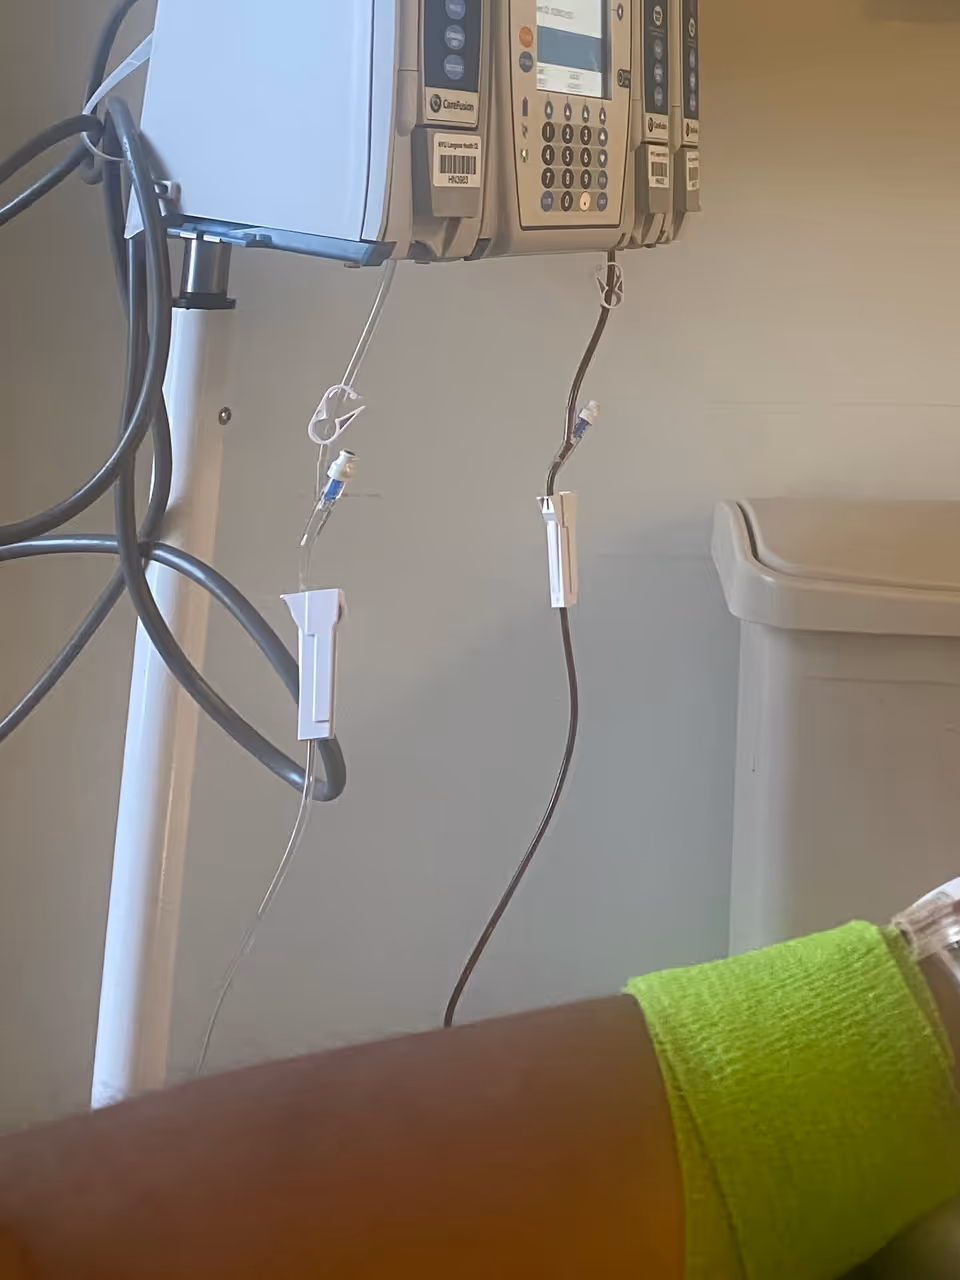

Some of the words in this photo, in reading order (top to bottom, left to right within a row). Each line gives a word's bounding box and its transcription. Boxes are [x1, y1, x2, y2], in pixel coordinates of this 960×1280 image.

[443, 99, 474, 112] CareFusion
[565, 128, 570, 139] 2
[545, 149, 550, 161] 4
[565, 151, 570, 162] 5
[584, 152, 589, 163] 6
[546, 172, 551, 184] 7
[565, 173, 570, 185] 8
[584, 174, 589, 185] 9
[564, 195, 570, 207] 0
